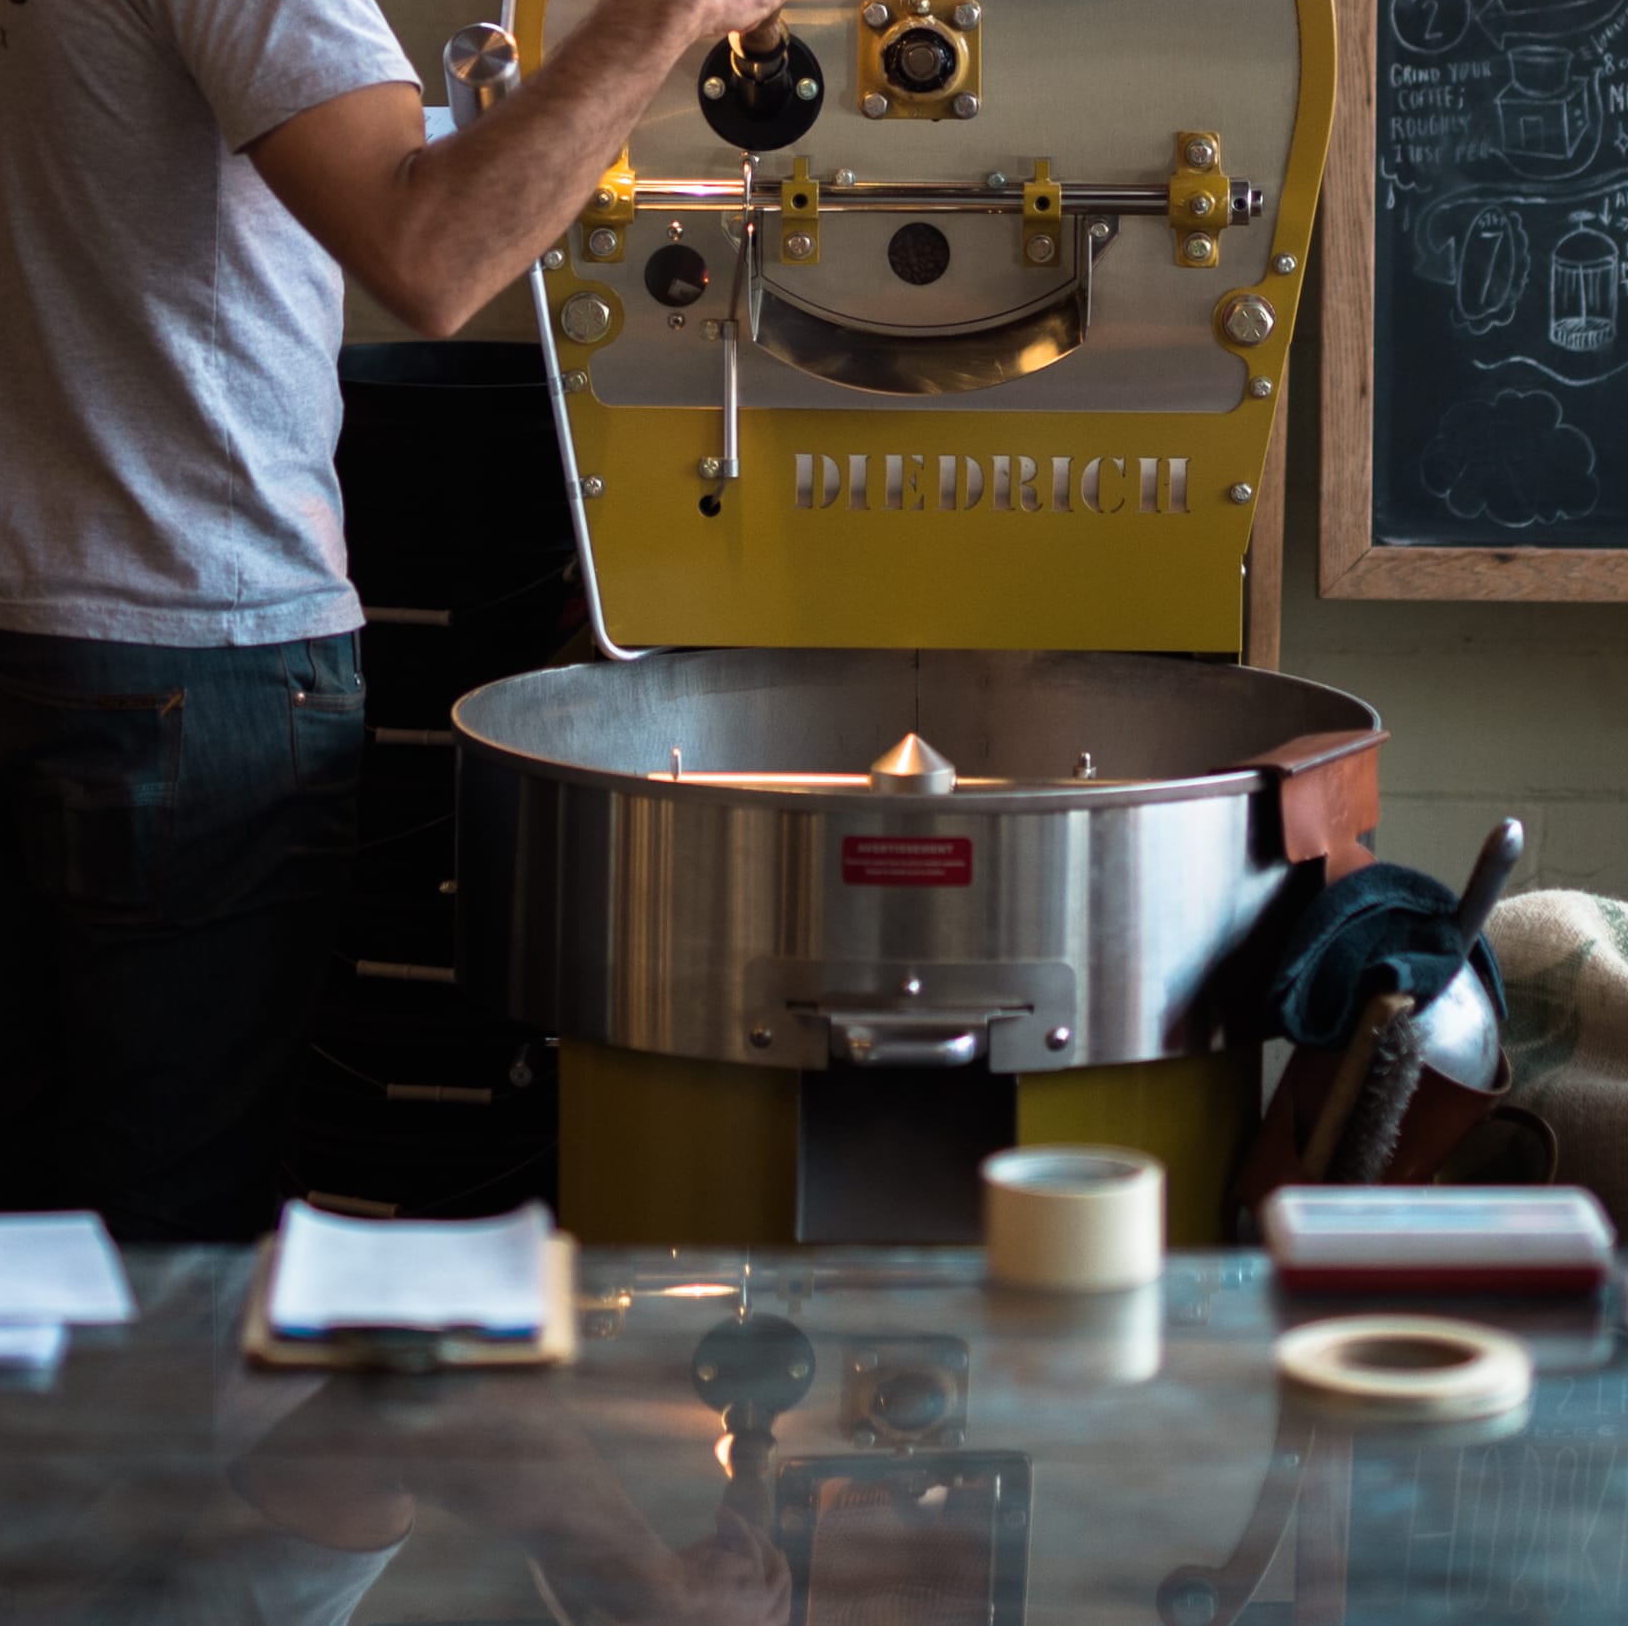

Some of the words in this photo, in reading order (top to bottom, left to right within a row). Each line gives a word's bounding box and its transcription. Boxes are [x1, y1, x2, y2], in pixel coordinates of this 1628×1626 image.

[1390, 61, 1443, 88] GRIND
[1447, 58, 1492, 83] YOUR
[1390, 112, 1472, 143] ROUGHLY
[794, 453, 1192, 514] DIEDRICH
